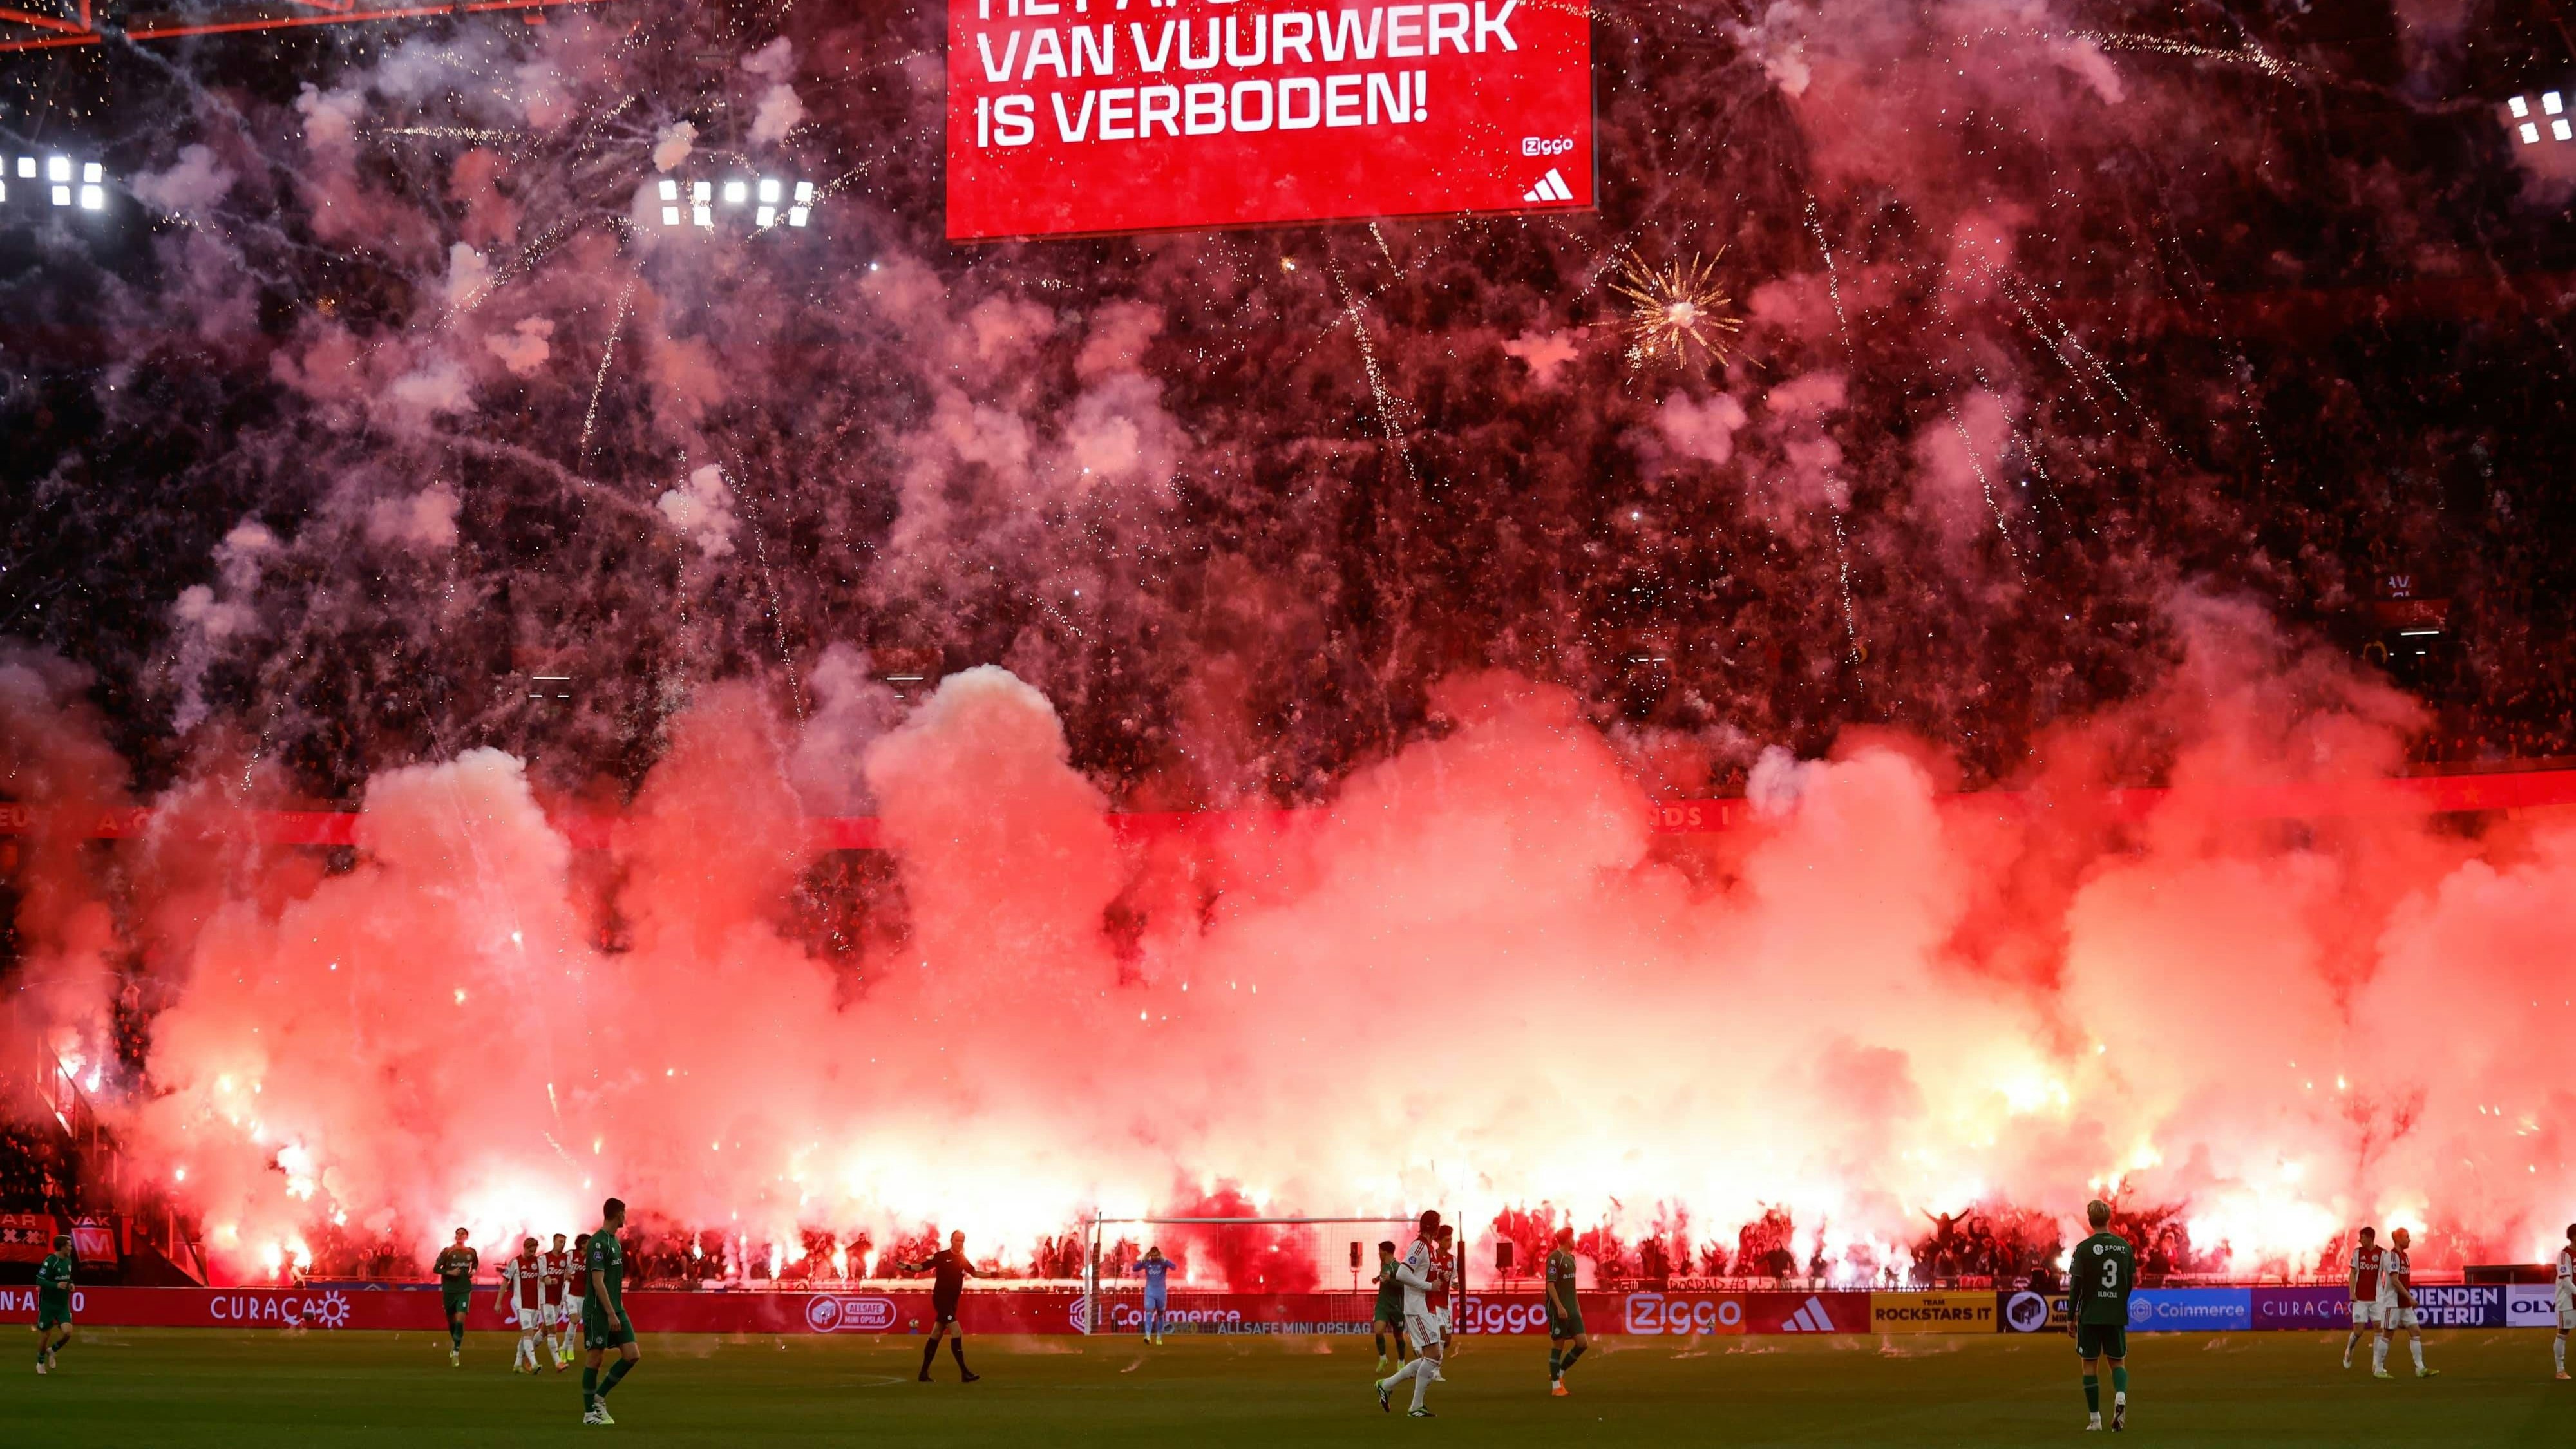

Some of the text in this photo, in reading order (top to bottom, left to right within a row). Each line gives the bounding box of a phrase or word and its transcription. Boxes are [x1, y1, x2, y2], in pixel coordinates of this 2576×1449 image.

[977, 0, 1518, 82] VAN VUURWERK
[978, 70, 1428, 147] IS VERBODEN!
[2102, 1259, 2118, 1288] 3
[849, 1304, 882, 1312] ALLSAFE
[1875, 1307, 1991, 1321] ROCKSTARS IT
[2158, 1301, 2245, 1318] Coinmerce
[1218, 1322, 1371, 1334] ALLSAFE MINI OPSLAG
